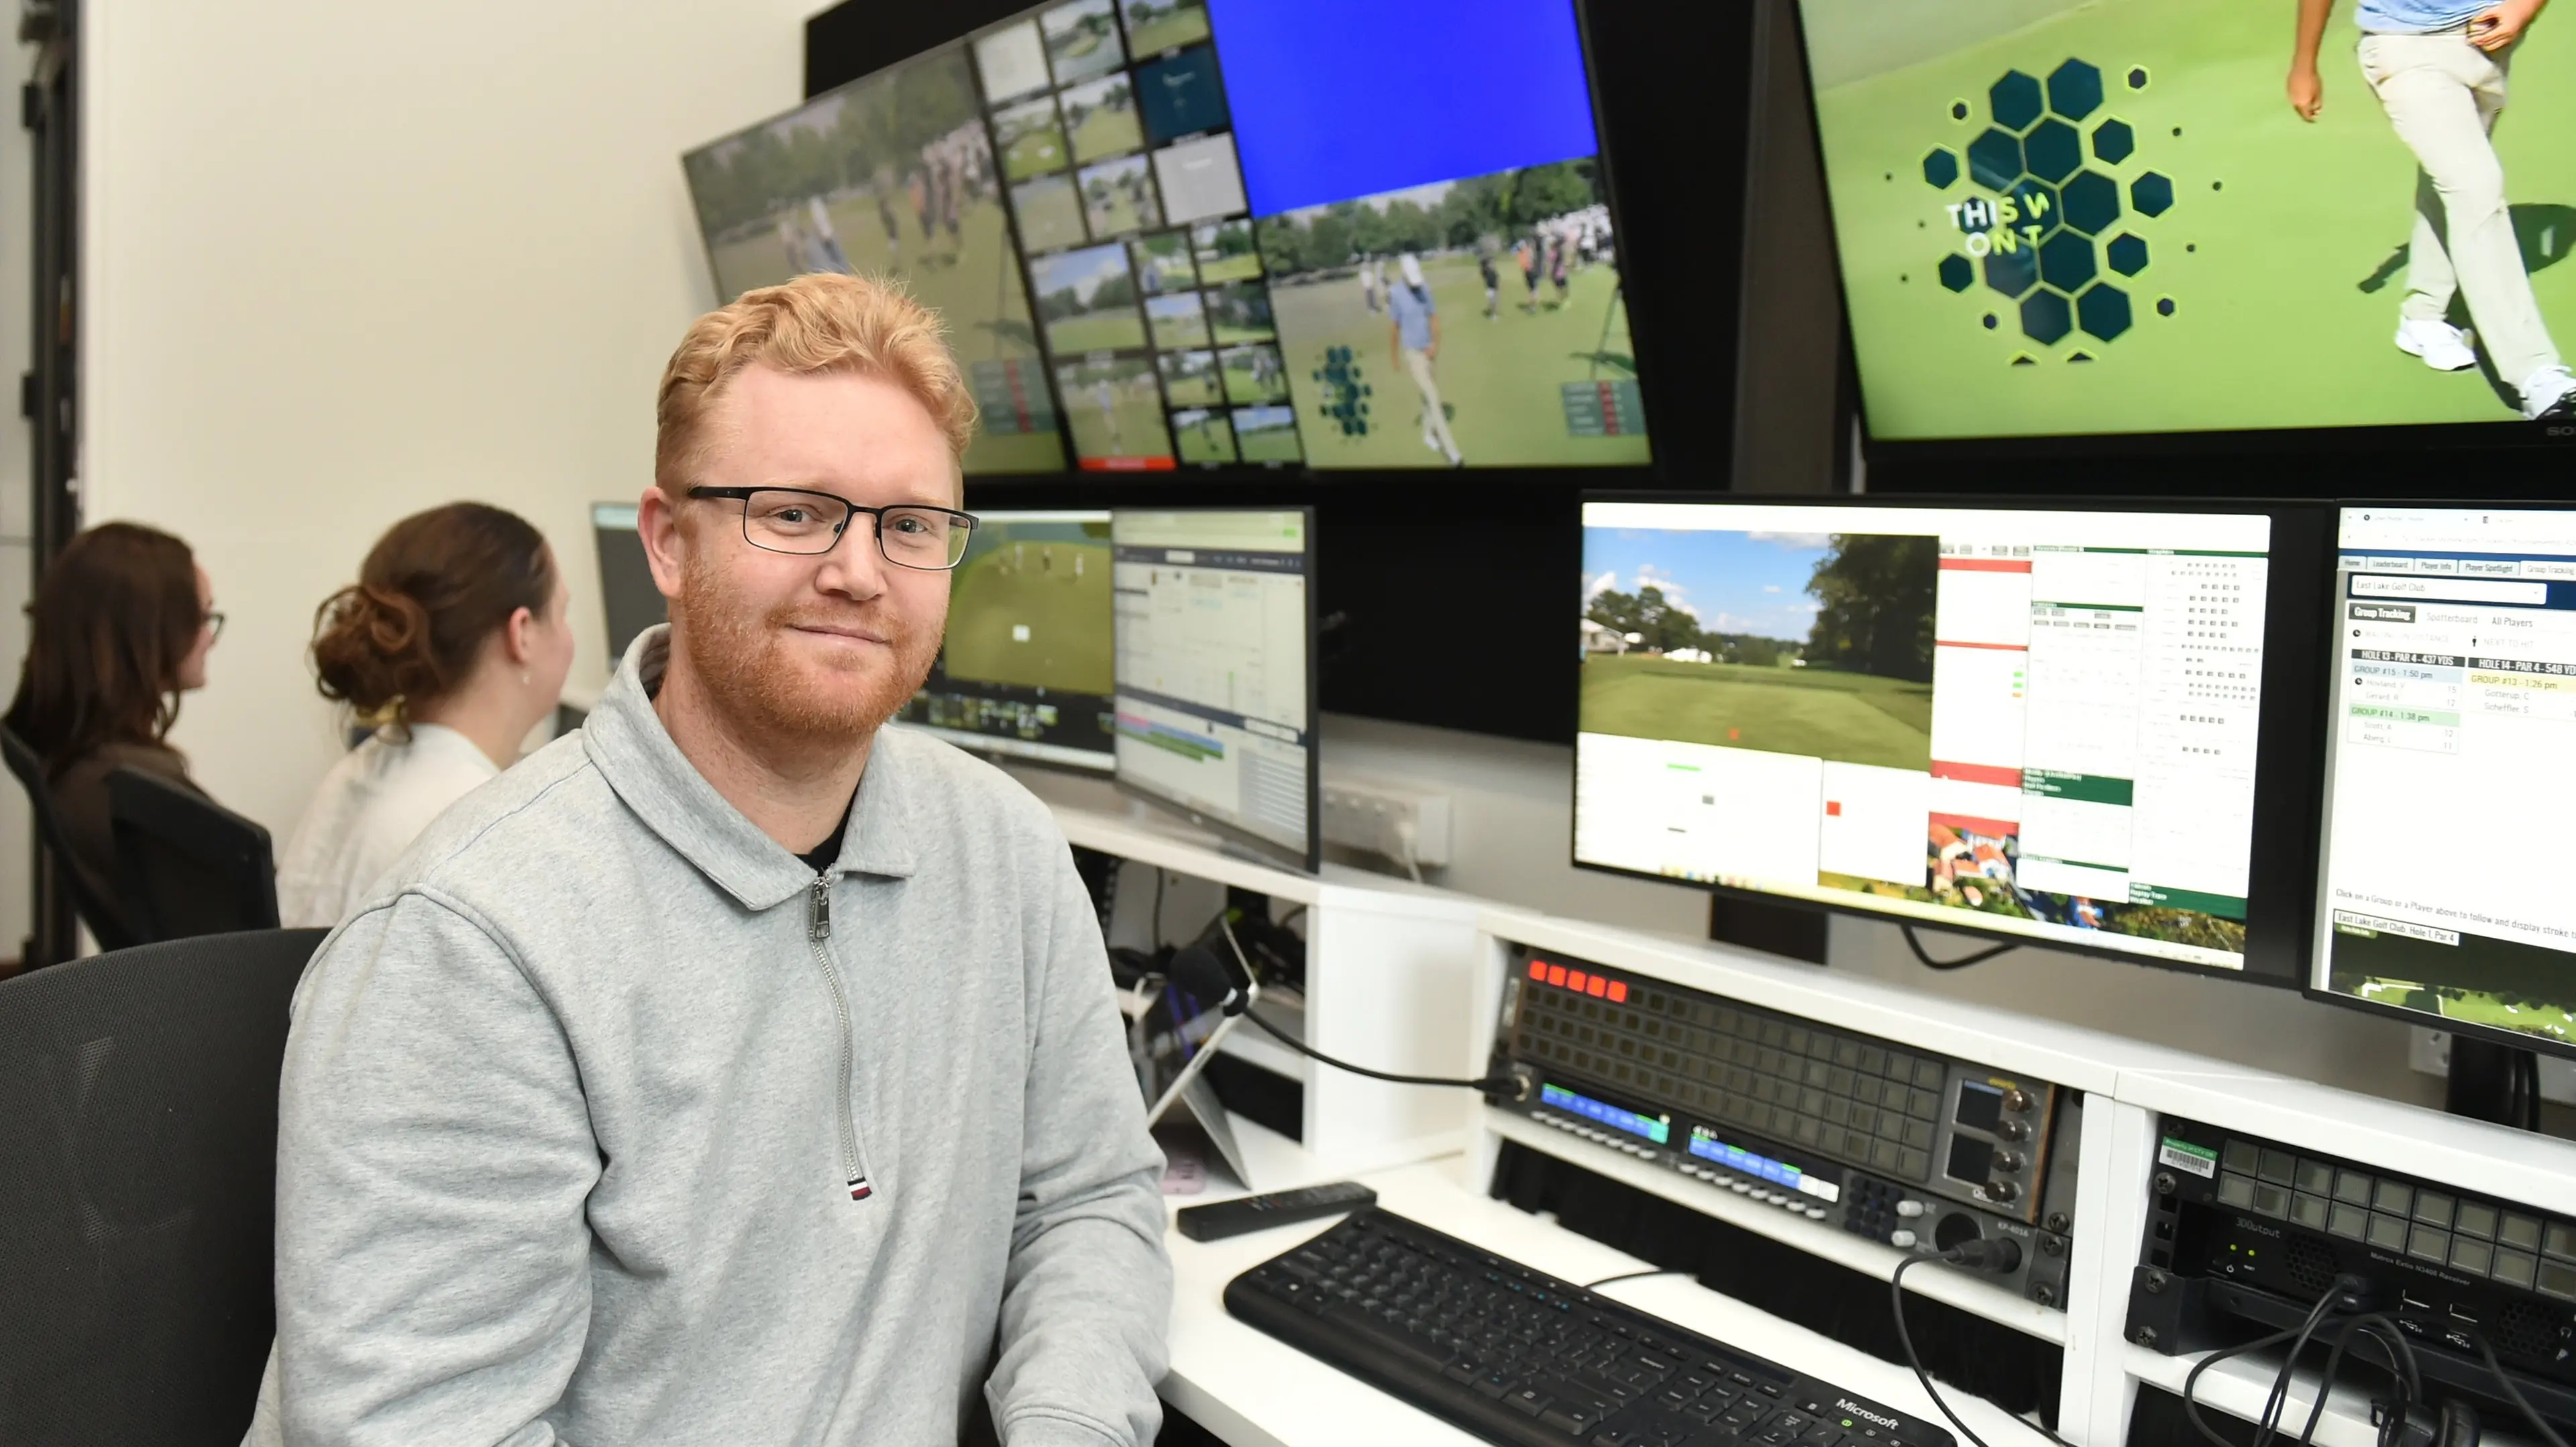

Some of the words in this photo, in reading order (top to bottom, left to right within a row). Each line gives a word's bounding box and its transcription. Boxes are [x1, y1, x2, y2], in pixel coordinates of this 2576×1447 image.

[1945, 197, 2019, 229] THIS
[1966, 228, 2017, 258] ON
[2546, 426, 2576, 436] SO
[2373, 560, 2408, 568] Leaderboard
[2421, 561, 2438, 570] Player
[2465, 563, 2483, 571] Player
[2485, 564, 2512, 574] Spotlight
[2528, 565, 2546, 574] Group
[2548, 566, 2575, 576] Tracking
[2373, 582, 2390, 590] Lake
[2392, 582, 2406, 590] Golf
[2408, 583, 2425, 592] Club
[2354, 606, 2377, 619] Group
[2378, 608, 2410, 621] Tracking
[2426, 612, 2477, 624] Spotterboard
[2492, 617, 2502, 625] All
[2504, 617, 2533, 628] Players
[2361, 651, 2380, 660] HOLE
[2382, 652, 2391, 661] 13
[2395, 653, 2410, 662] PAR
[2422, 655, 2436, 663] 437
[2438, 656, 2454, 665] YDS
[2355, 665, 2380, 674] GROUP
[2382, 667, 2396, 676] #15
[2479, 659, 2501, 669] HOLE
[2502, 661, 2510, 669] 14
[2516, 661, 2532, 671] PAR
[2534, 663, 2539, 672] 4
[2545, 664, 2563, 674] 548
[2471, 675, 2500, 684] GROUP
[2502, 678, 2517, 686] #13
[2526, 680, 2542, 688] 1:26
[2351, 706, 2377, 716] GROUP
[2380, 709, 2394, 718] #14
[2336, 888, 2352, 898] Click
[2371, 895, 2393, 906] Group
[2410, 902, 2433, 912] Player
[2436, 908, 2457, 918] above
[2460, 911, 2467, 919] to
[2470, 913, 2491, 923] follow
[2495, 918, 2509, 927] and
[2512, 920, 2540, 933] display
[2542, 926, 2569, 938] stroke
[2339, 912, 2353, 923] East
[2355, 915, 2371, 926] Lake
[2373, 919, 2387, 930] Golf
[2410, 926, 2426, 937] Hole
[2434, 930, 2447, 941] Par
[2449, 934, 2454, 942] 4
[2439, 1272, 2471, 1286] Receiver
[1835, 1398, 1900, 1430] Microsoft
